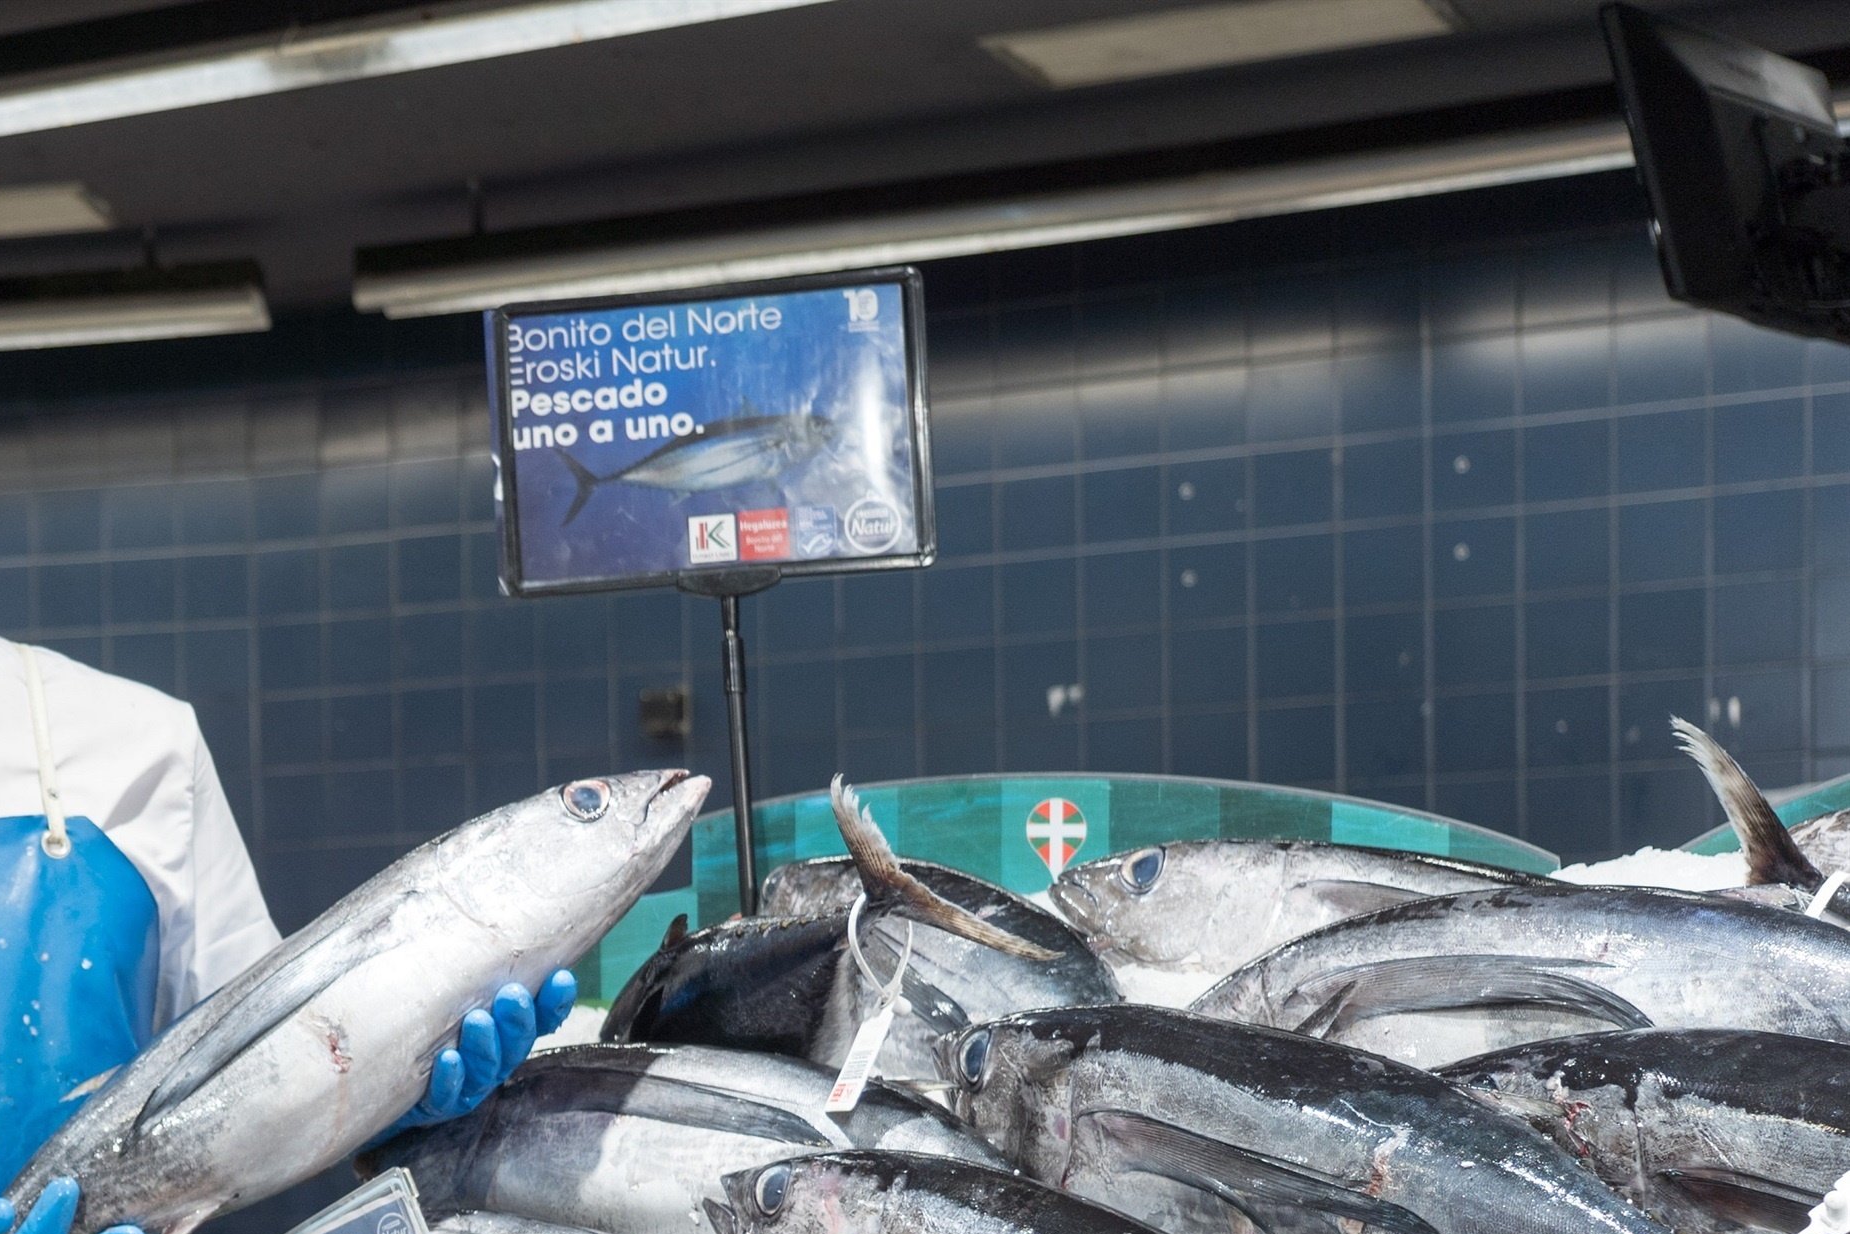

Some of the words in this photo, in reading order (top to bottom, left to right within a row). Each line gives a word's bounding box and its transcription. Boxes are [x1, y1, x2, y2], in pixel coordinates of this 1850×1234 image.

[509, 319, 612, 353] Bonito
[622, 310, 675, 342] del
[687, 303, 782, 336] Norte
[612, 343, 716, 376] Natur.
[511, 378, 668, 417] Pescado
[513, 425, 578, 450] uno
[589, 419, 613, 443] a
[625, 412, 704, 440] uno.
